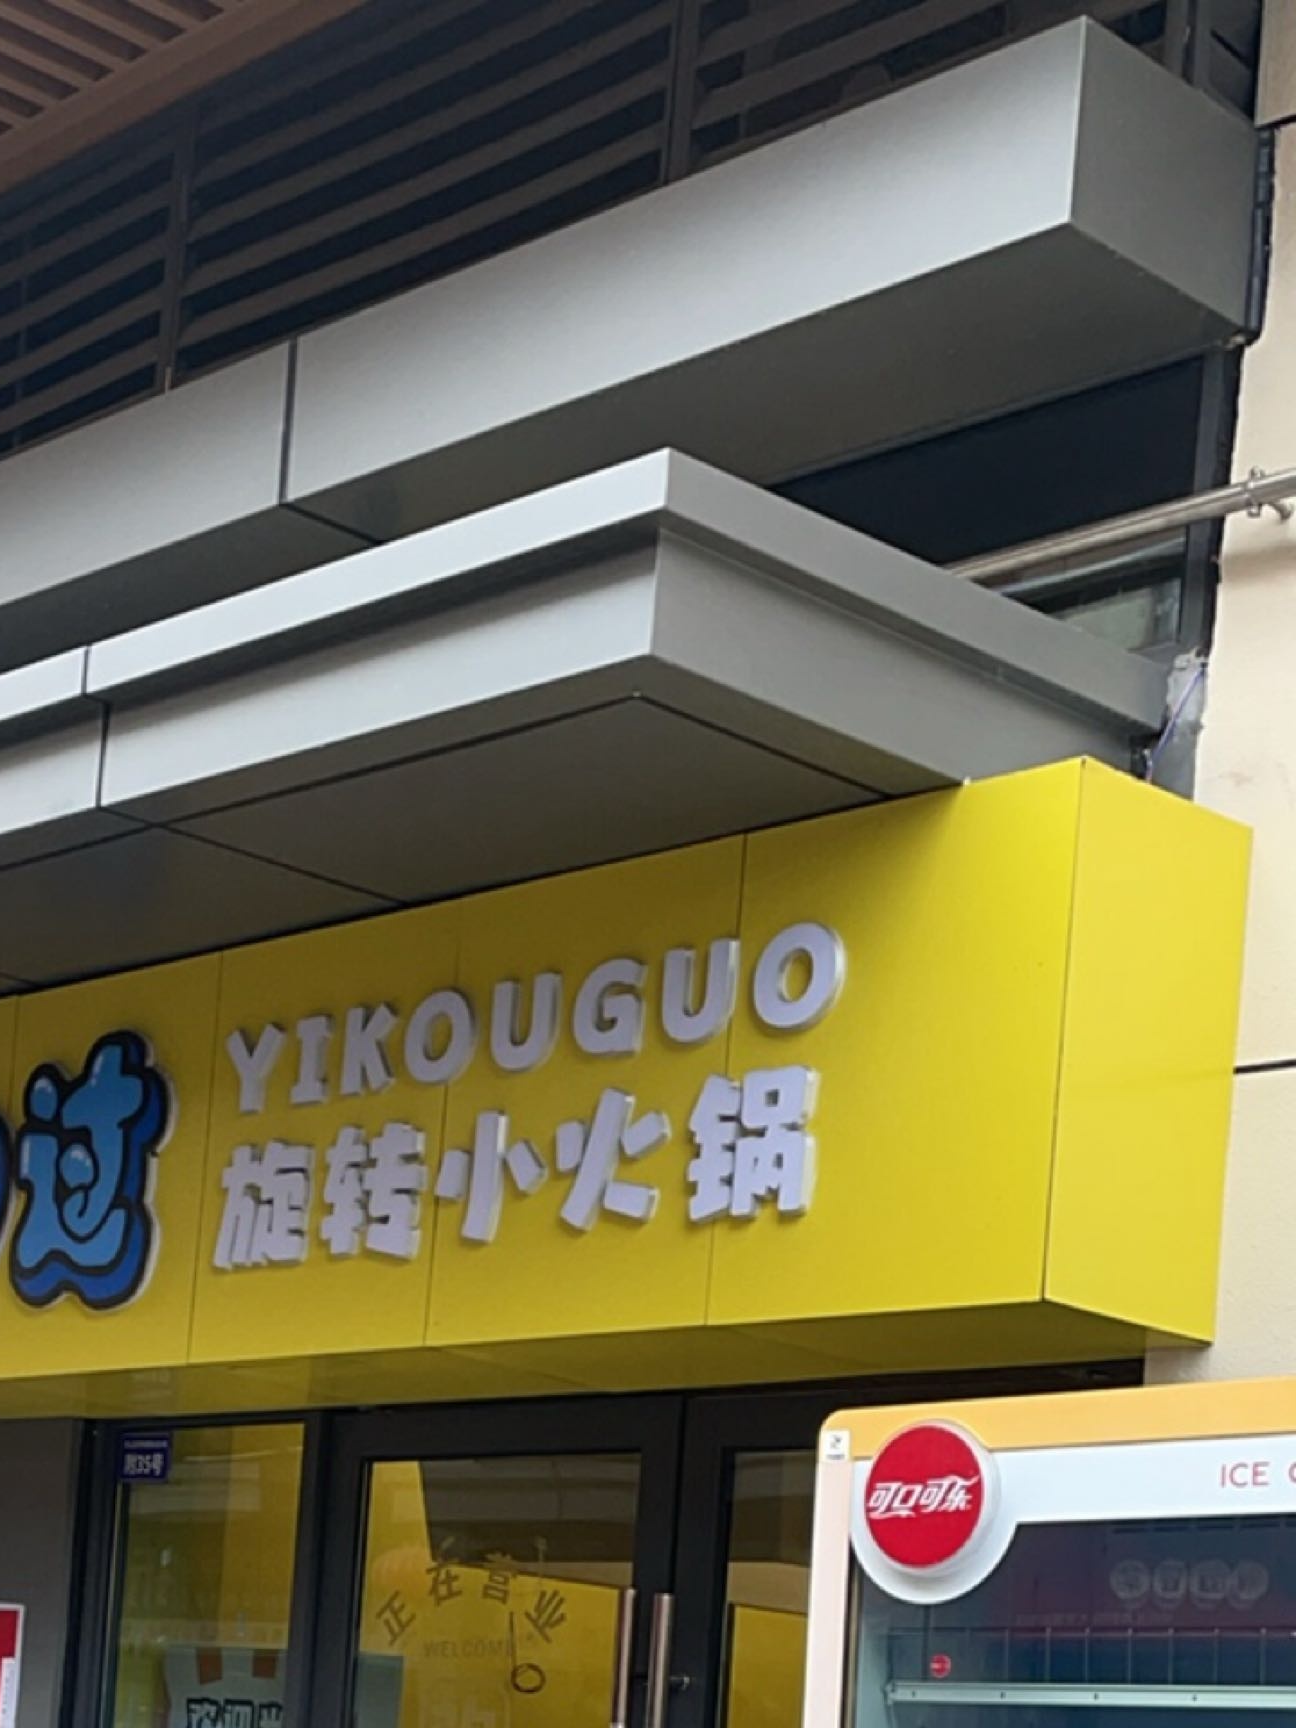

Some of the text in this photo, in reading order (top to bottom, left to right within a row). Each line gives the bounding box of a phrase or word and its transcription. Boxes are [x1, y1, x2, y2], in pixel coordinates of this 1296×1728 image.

[224, 921, 846, 1114] YIKOUGUO
[211, 1064, 820, 1271] 旋转小火锅
[868, 1475, 980, 1519] 可口可乐
[1220, 1461, 1270, 1488] ICE
[376, 1553, 567, 1646] 正在营业
